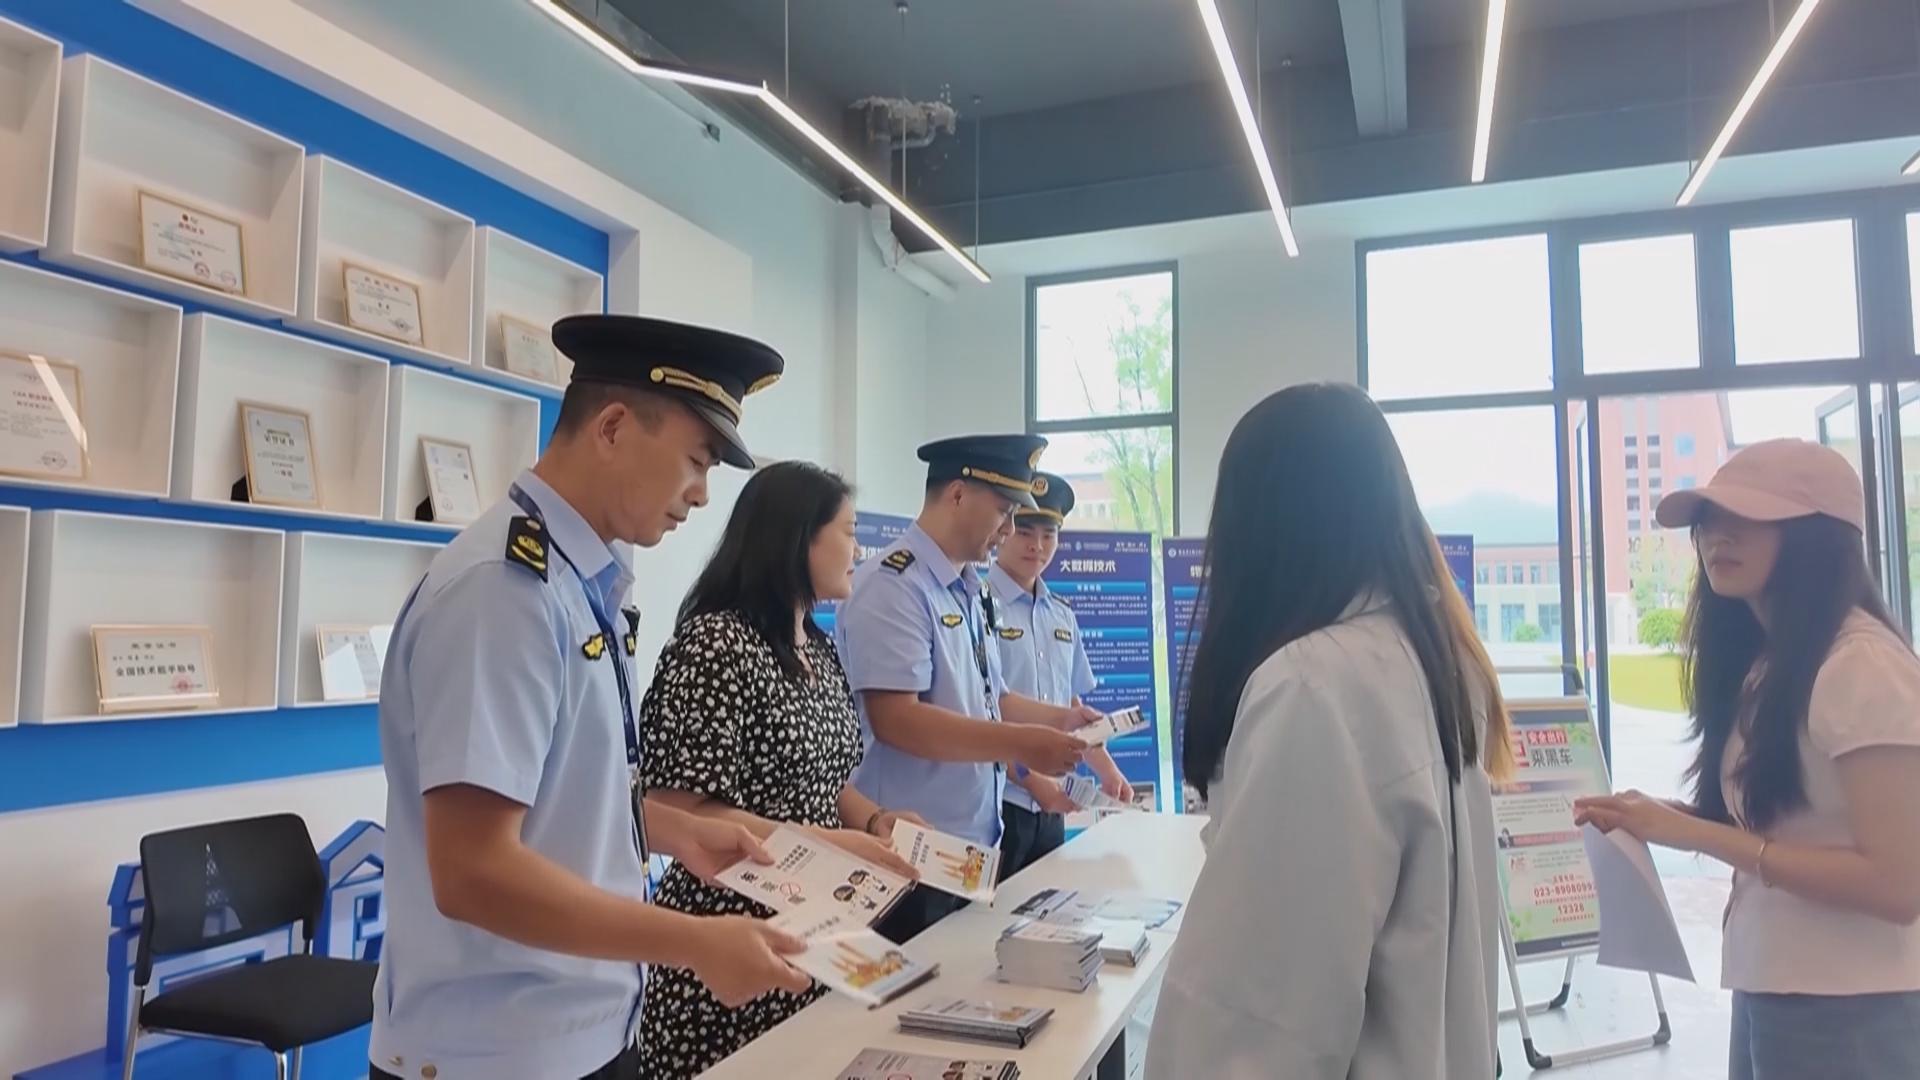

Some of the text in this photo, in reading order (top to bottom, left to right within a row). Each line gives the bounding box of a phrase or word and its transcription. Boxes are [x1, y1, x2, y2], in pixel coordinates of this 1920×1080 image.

[1060, 559, 1117, 574] 大数据技术
[1531, 747, 1574, 768] 乘黑车
[1557, 902, 1585, 915] 12328
